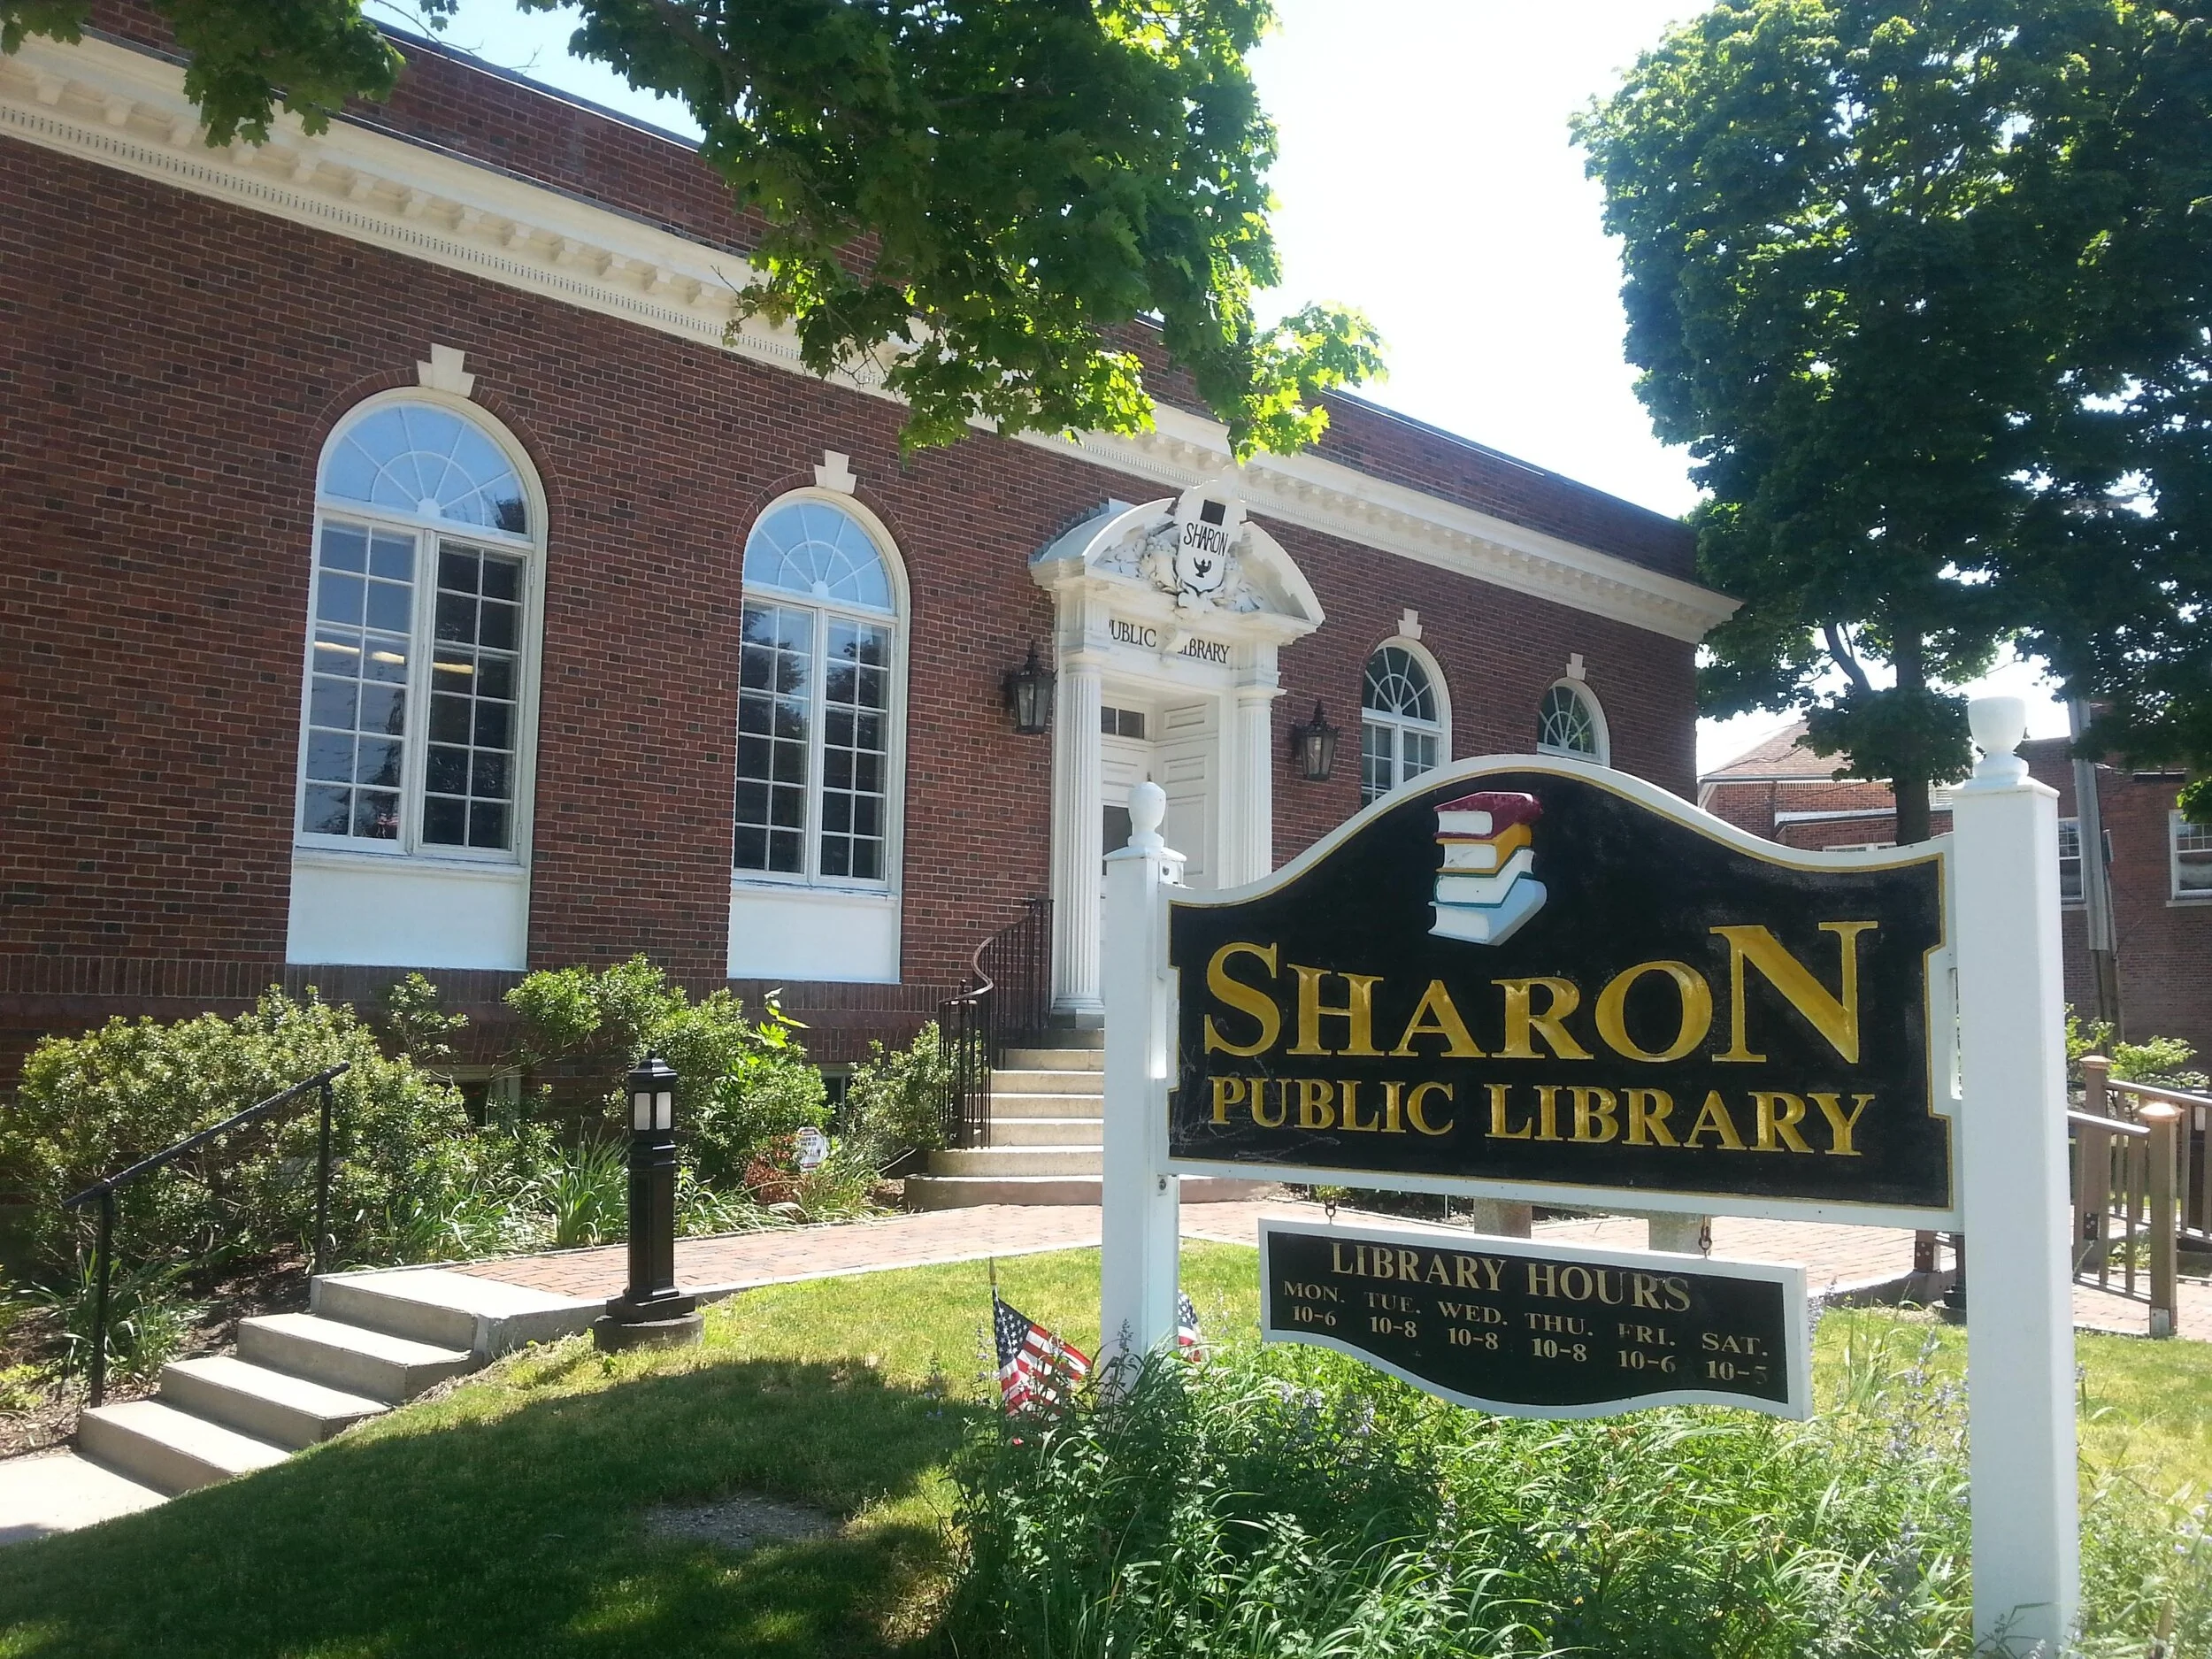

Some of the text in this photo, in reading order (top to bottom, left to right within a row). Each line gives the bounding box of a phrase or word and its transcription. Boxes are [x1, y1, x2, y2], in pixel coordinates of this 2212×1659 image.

[1183, 522, 1229, 557] SHARON
[1177, 637, 1230, 664] BRARY
[1204, 920, 1878, 1064] SHARON
[1208, 1075, 1877, 1156] PUBLIC LIBRARY
[1330, 1241, 1691, 1312] LIBRARY HOURS
[1284, 1281, 1768, 1356] MON. TUE. WED. THU. FRI. SAT.
[1293, 1305, 1768, 1385] 10-6 10-8 10-8 10-8 10-6 10-5
